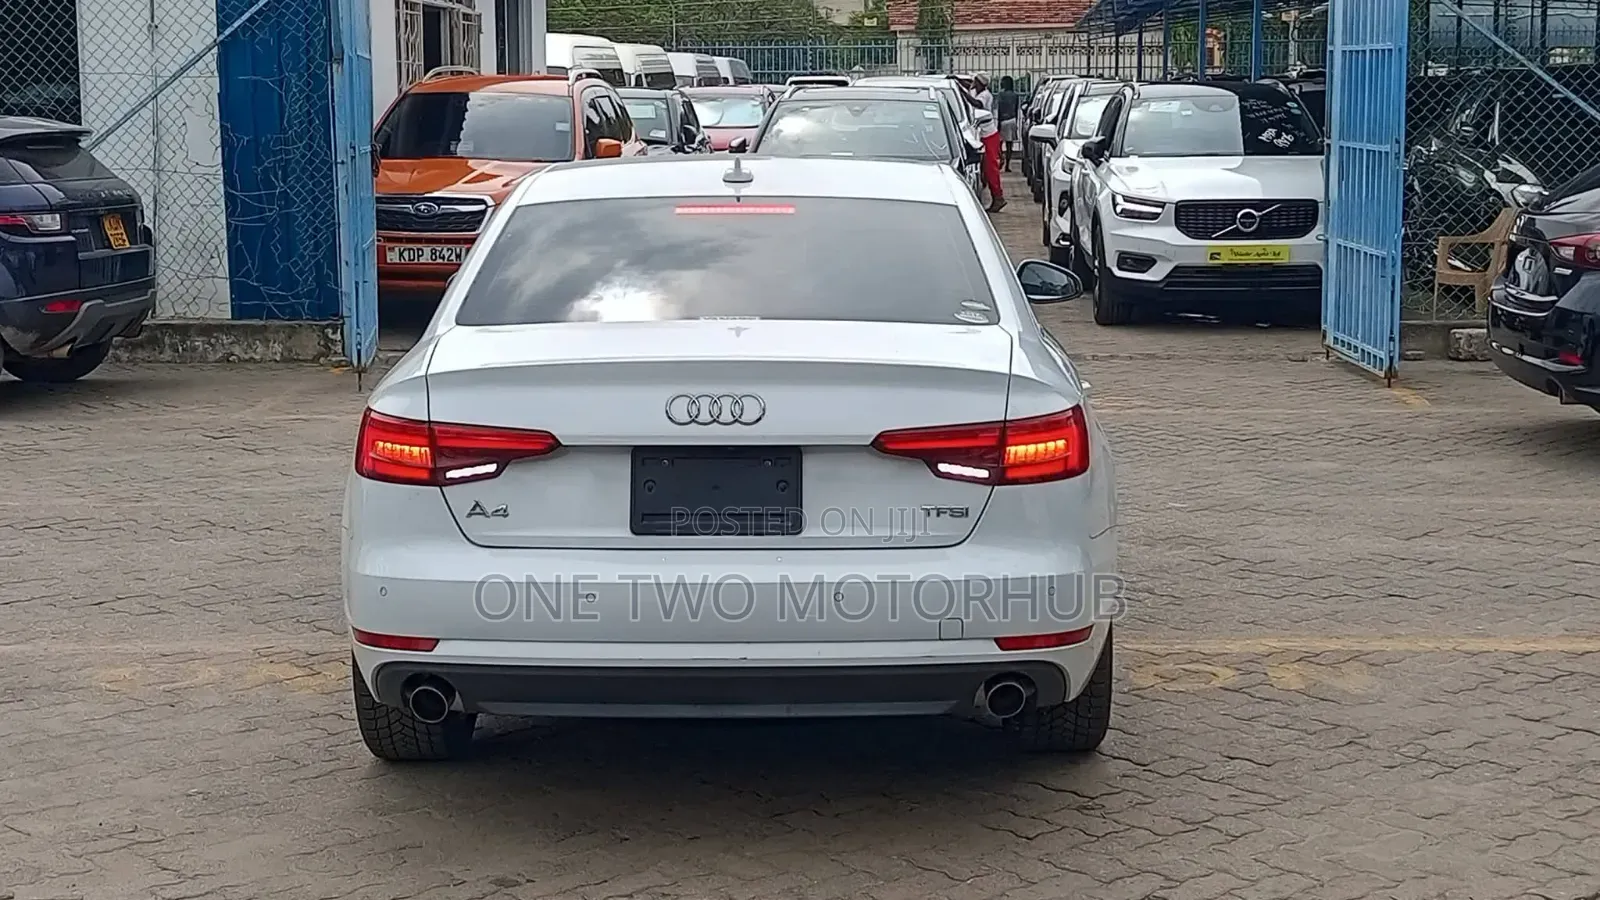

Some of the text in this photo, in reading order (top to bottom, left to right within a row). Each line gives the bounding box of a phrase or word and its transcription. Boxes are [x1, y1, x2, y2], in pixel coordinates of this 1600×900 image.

[399, 247, 462, 262] KDP 842W
[466, 500, 509, 519] A4
[921, 504, 970, 519] TFSI
